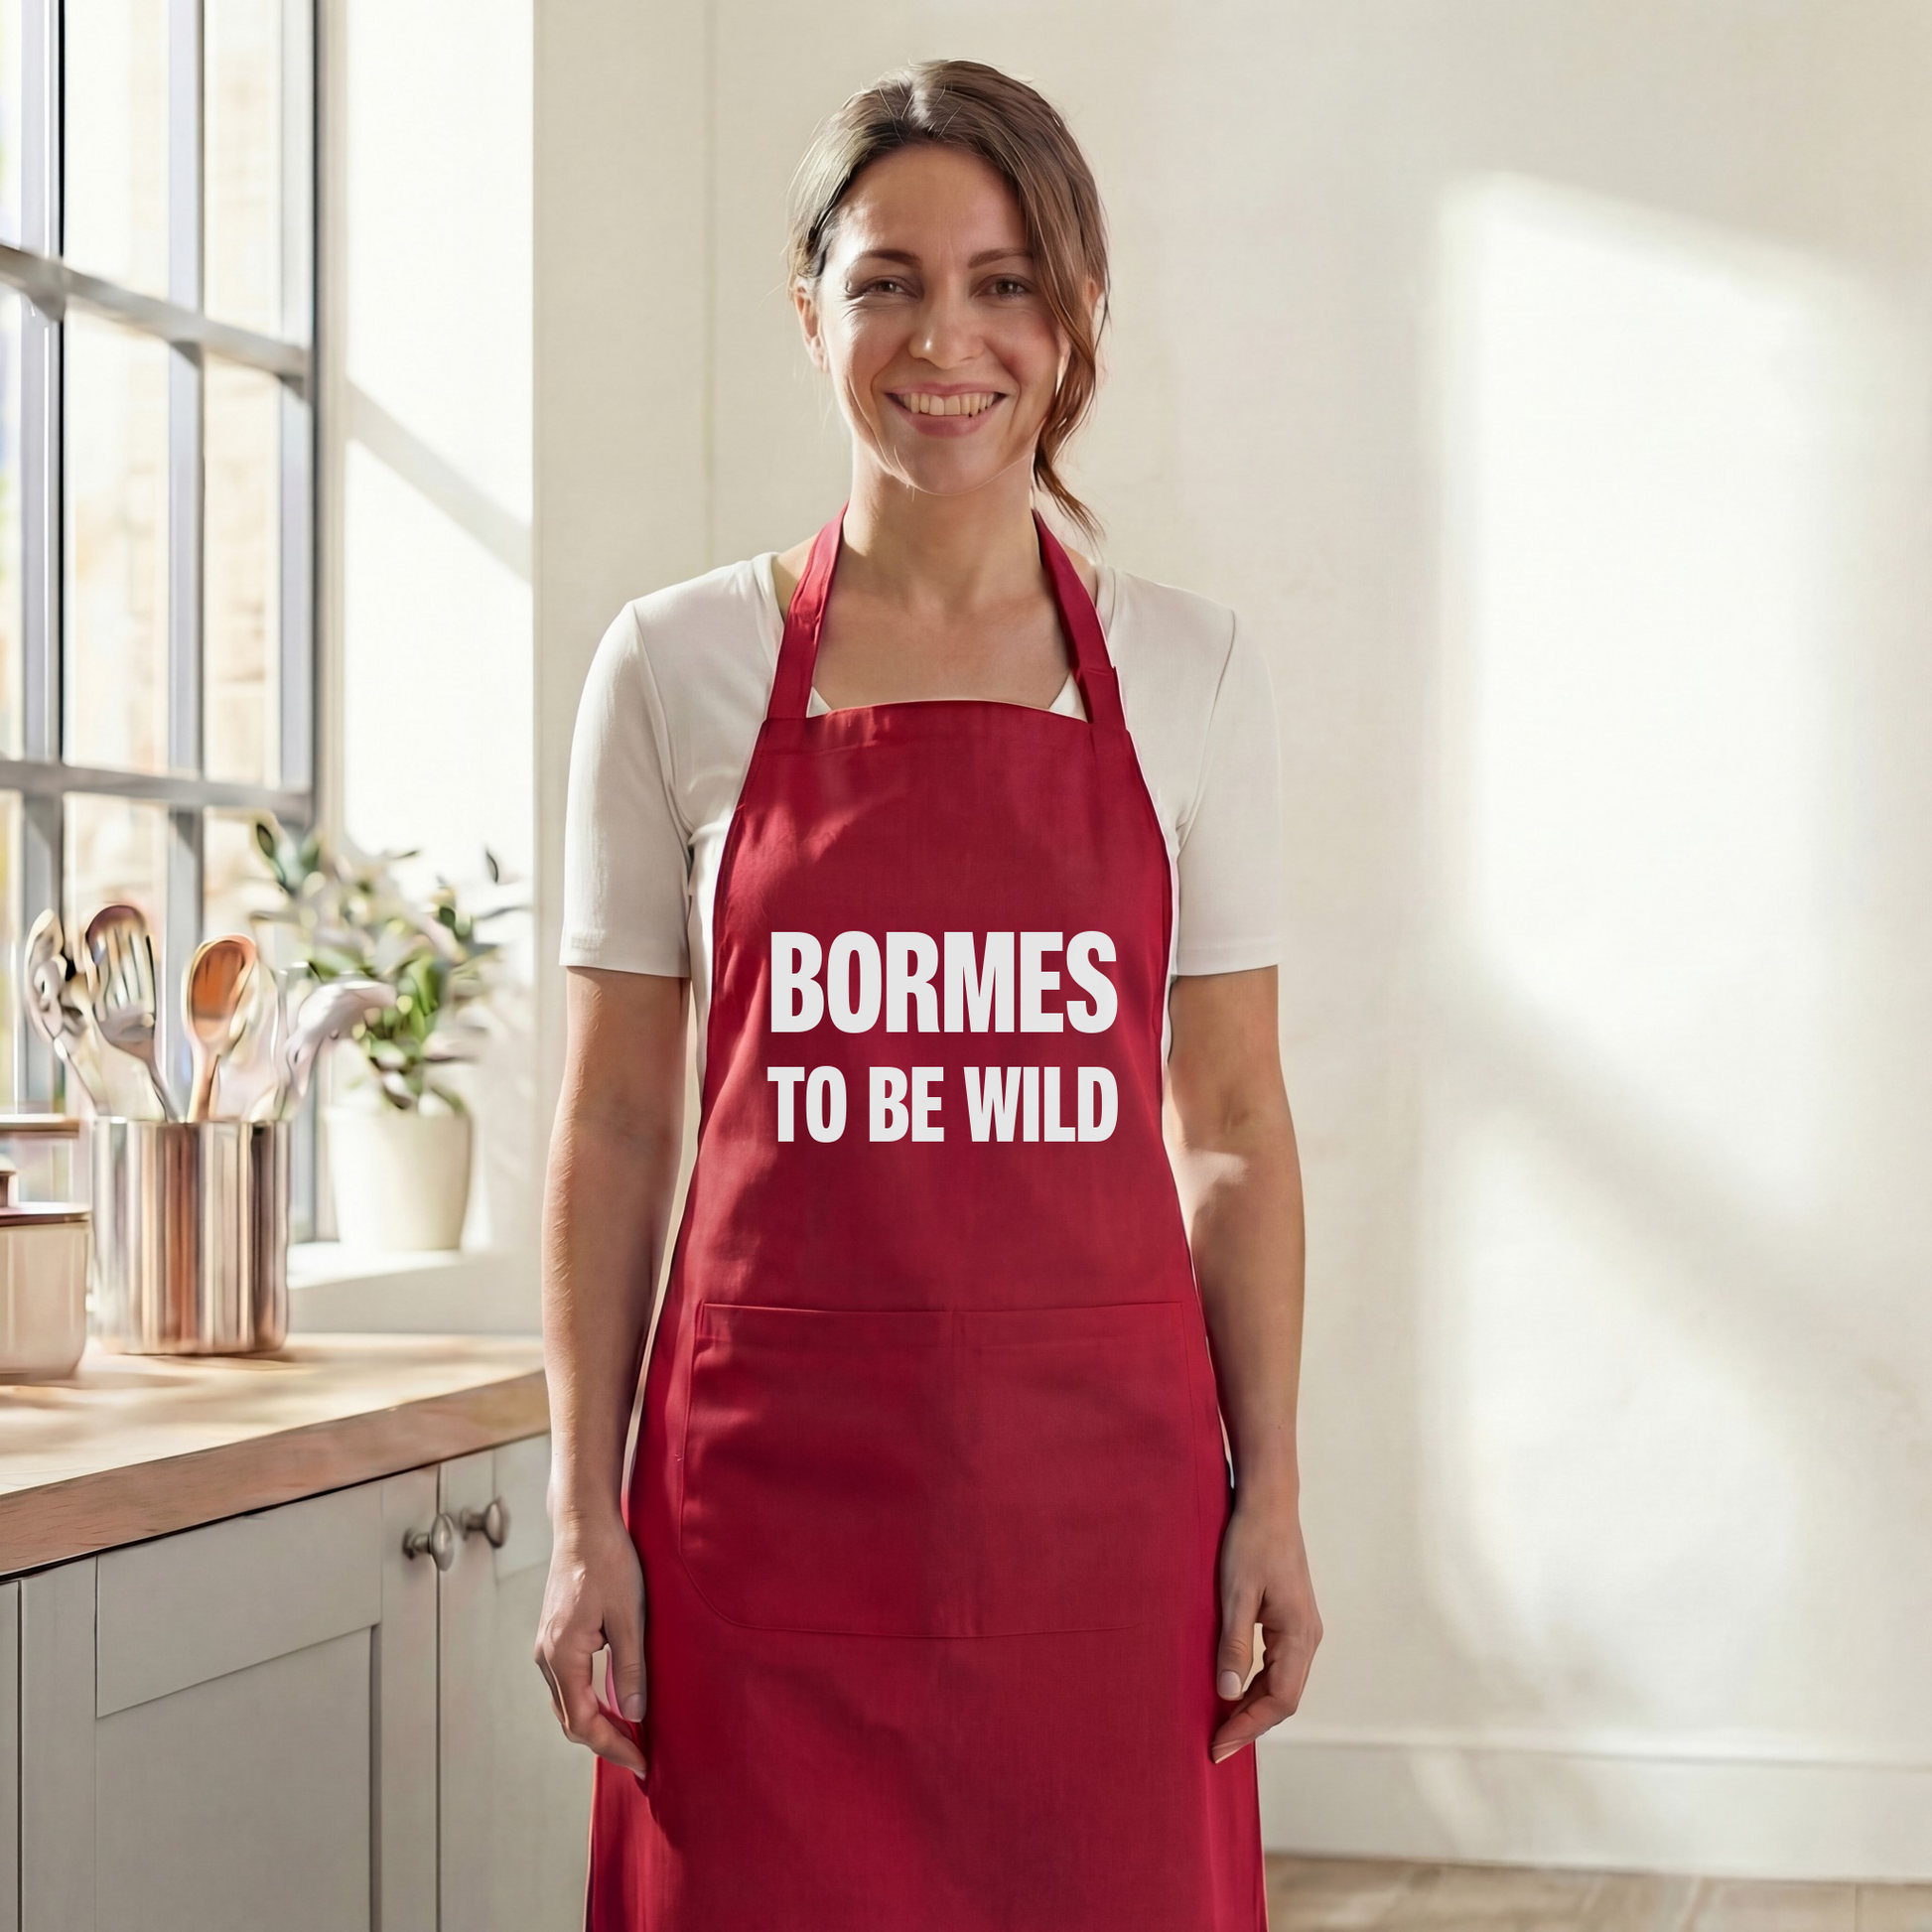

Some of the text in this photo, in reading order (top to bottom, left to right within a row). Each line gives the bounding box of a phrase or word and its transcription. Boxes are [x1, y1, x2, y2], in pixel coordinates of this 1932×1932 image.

[770, 931, 1118, 1034] BORMES
[767, 1066, 1119, 1143] TO BE WILD
